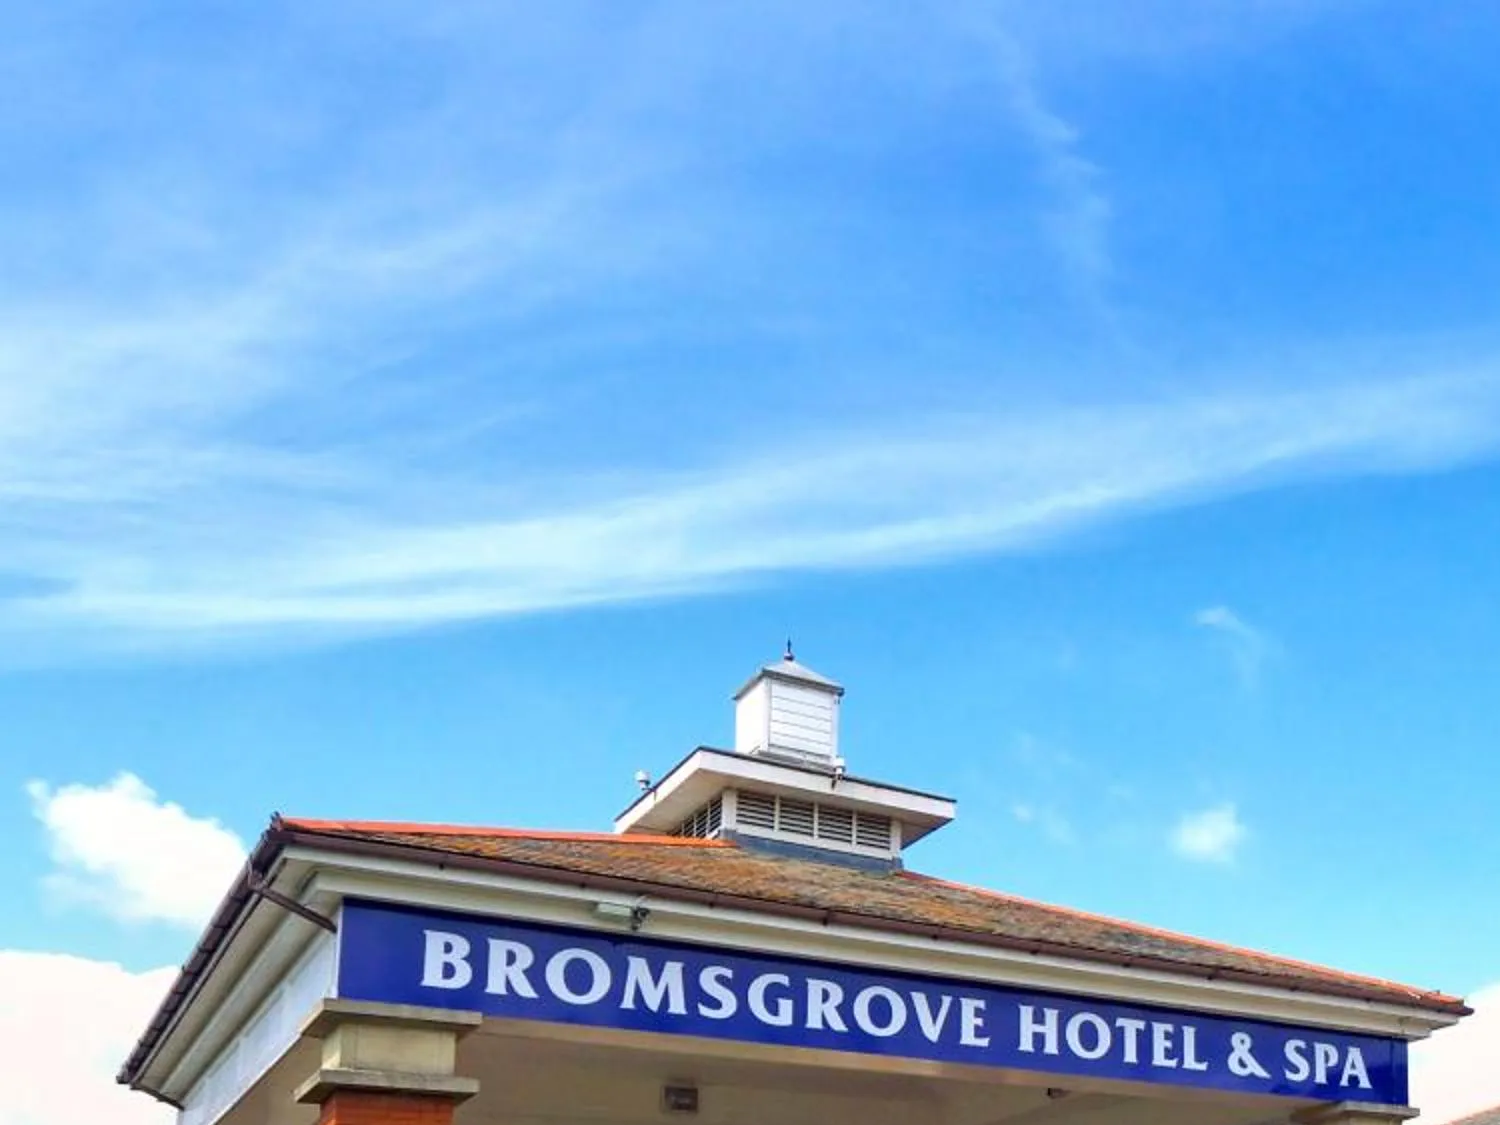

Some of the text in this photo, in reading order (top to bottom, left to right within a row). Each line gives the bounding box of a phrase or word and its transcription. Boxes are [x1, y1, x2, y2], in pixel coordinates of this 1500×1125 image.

[422, 930, 1373, 1089] BROMSGROVE HOTEL & SPA
